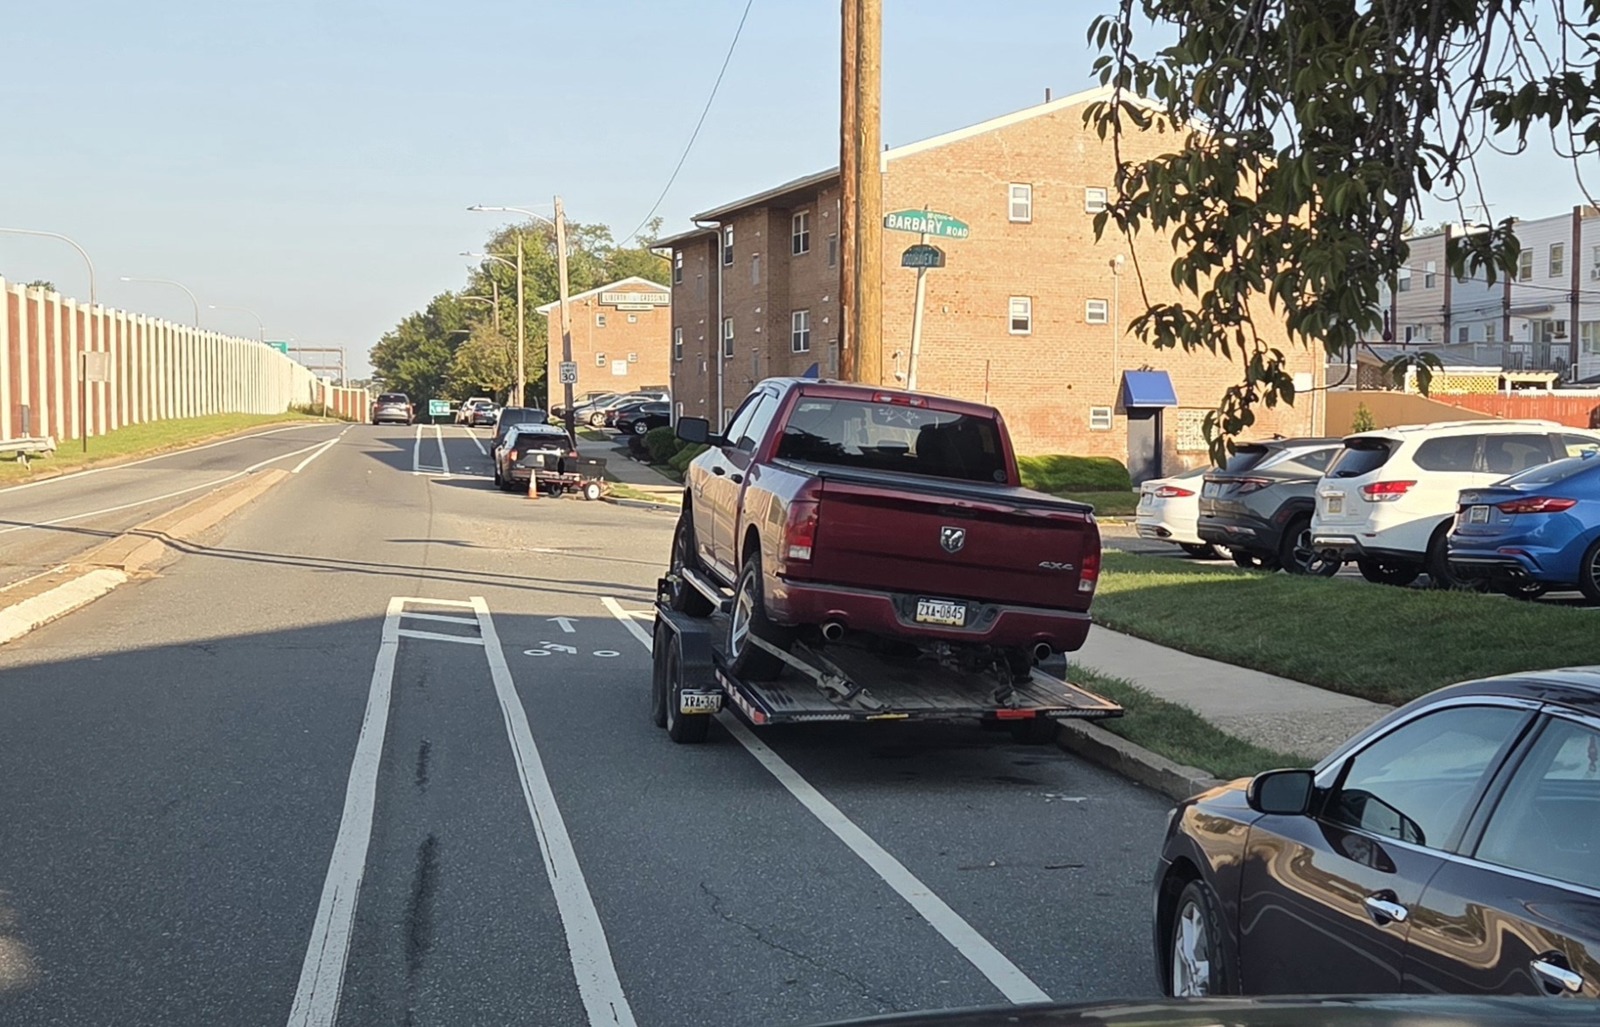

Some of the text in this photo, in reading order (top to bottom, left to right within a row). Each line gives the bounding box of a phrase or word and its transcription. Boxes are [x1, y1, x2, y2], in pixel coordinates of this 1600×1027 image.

[888, 213, 943, 234] BARBARY
[946, 226, 969, 238] ROAD
[562, 373, 576, 382] 30
